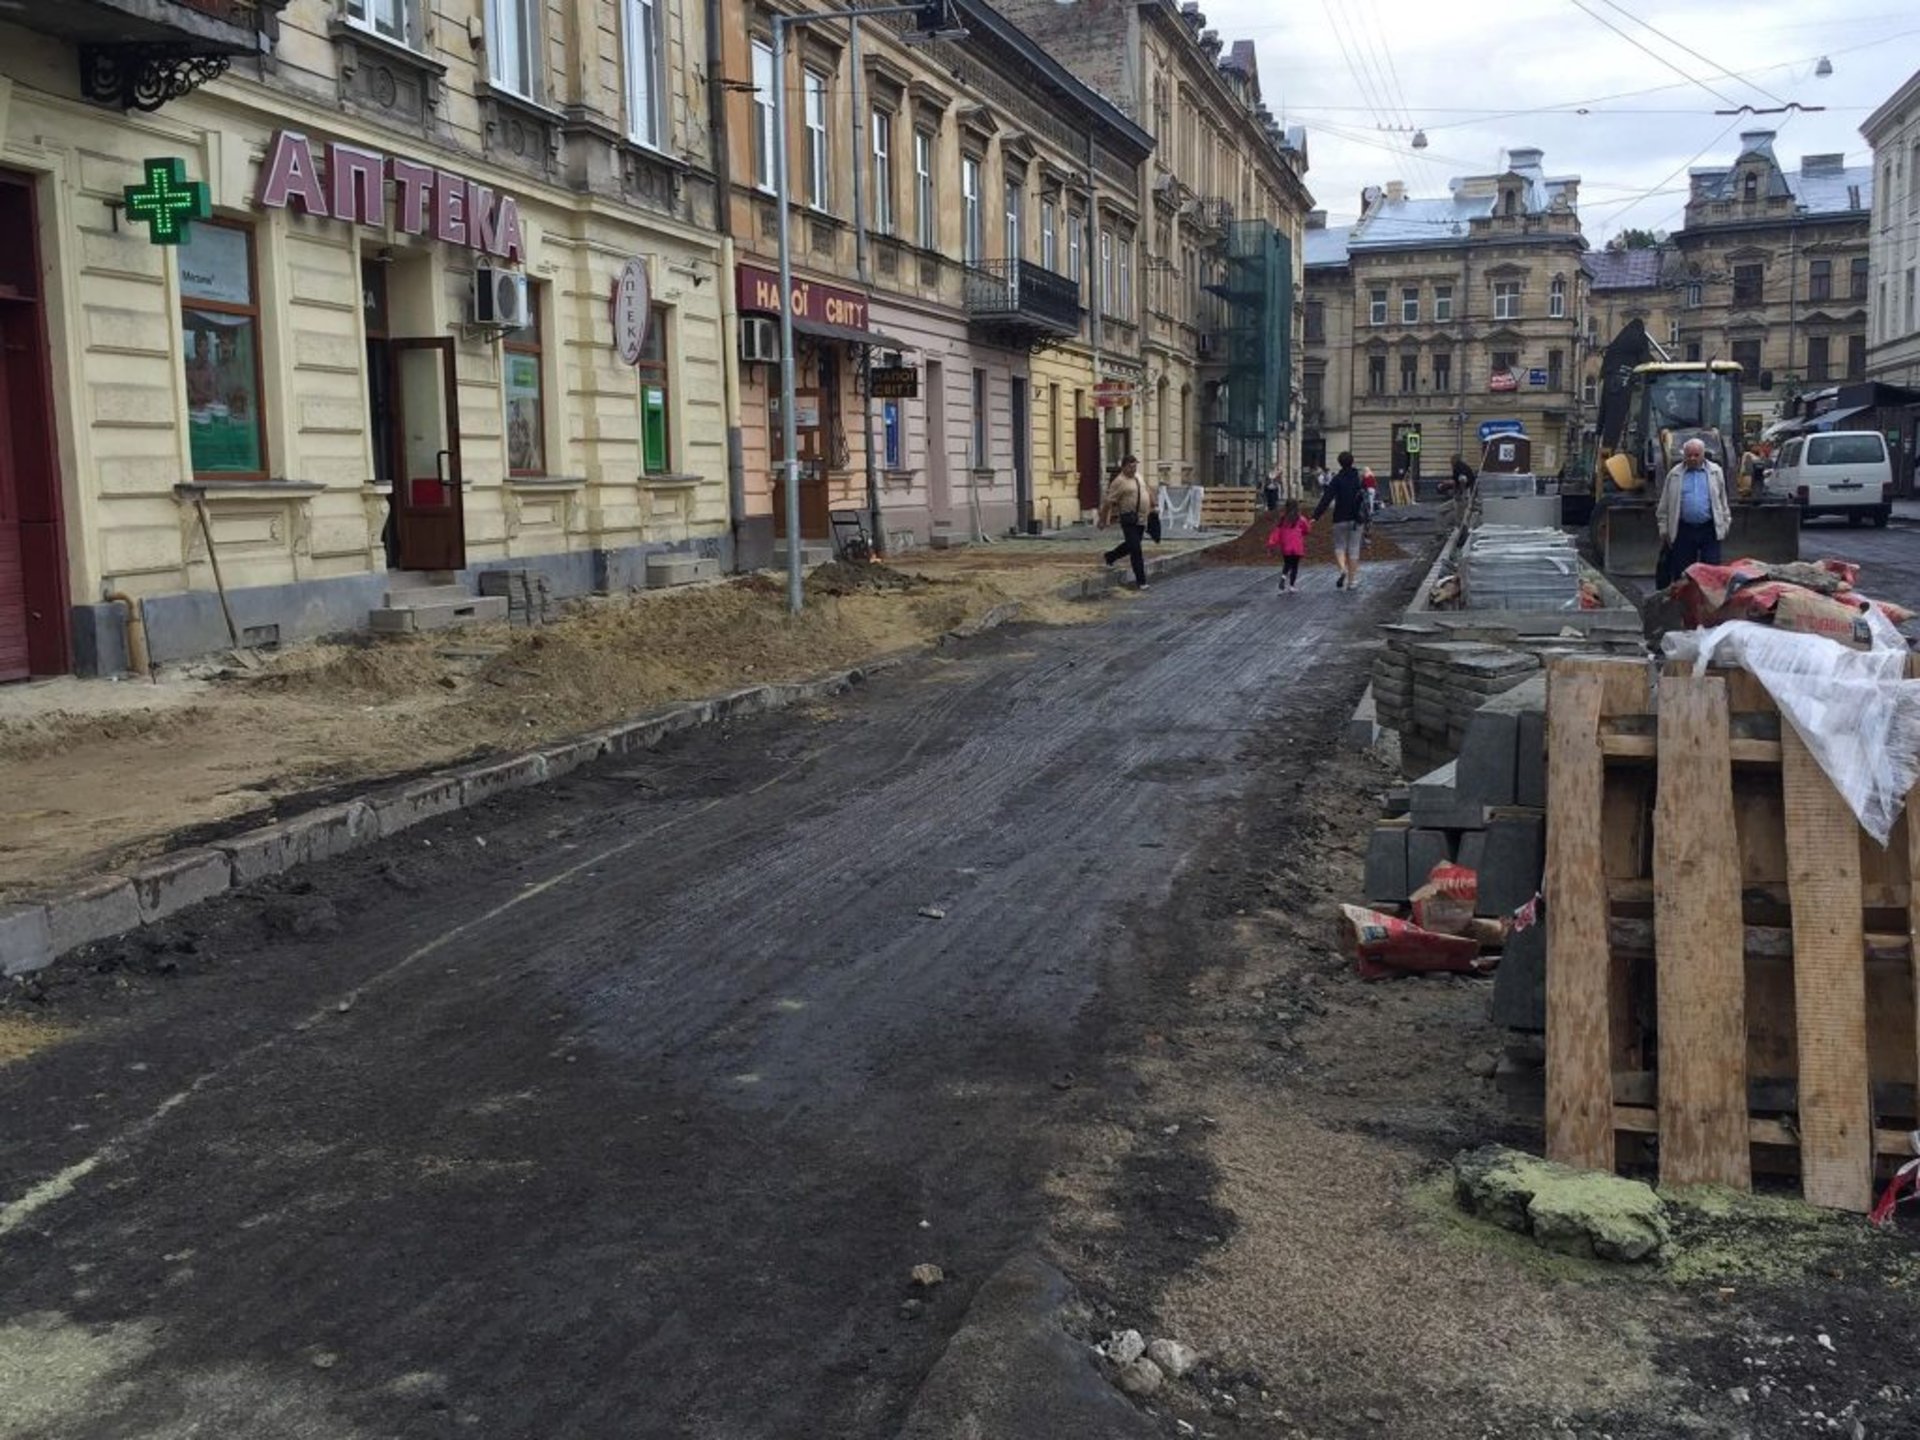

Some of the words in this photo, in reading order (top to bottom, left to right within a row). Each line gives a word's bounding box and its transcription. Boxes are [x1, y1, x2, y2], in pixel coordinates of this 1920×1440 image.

[261, 129, 526, 264] АПТЕКА
[625, 265, 637, 353] АПТЕКА
[756, 280, 809, 317] НАОЇ
